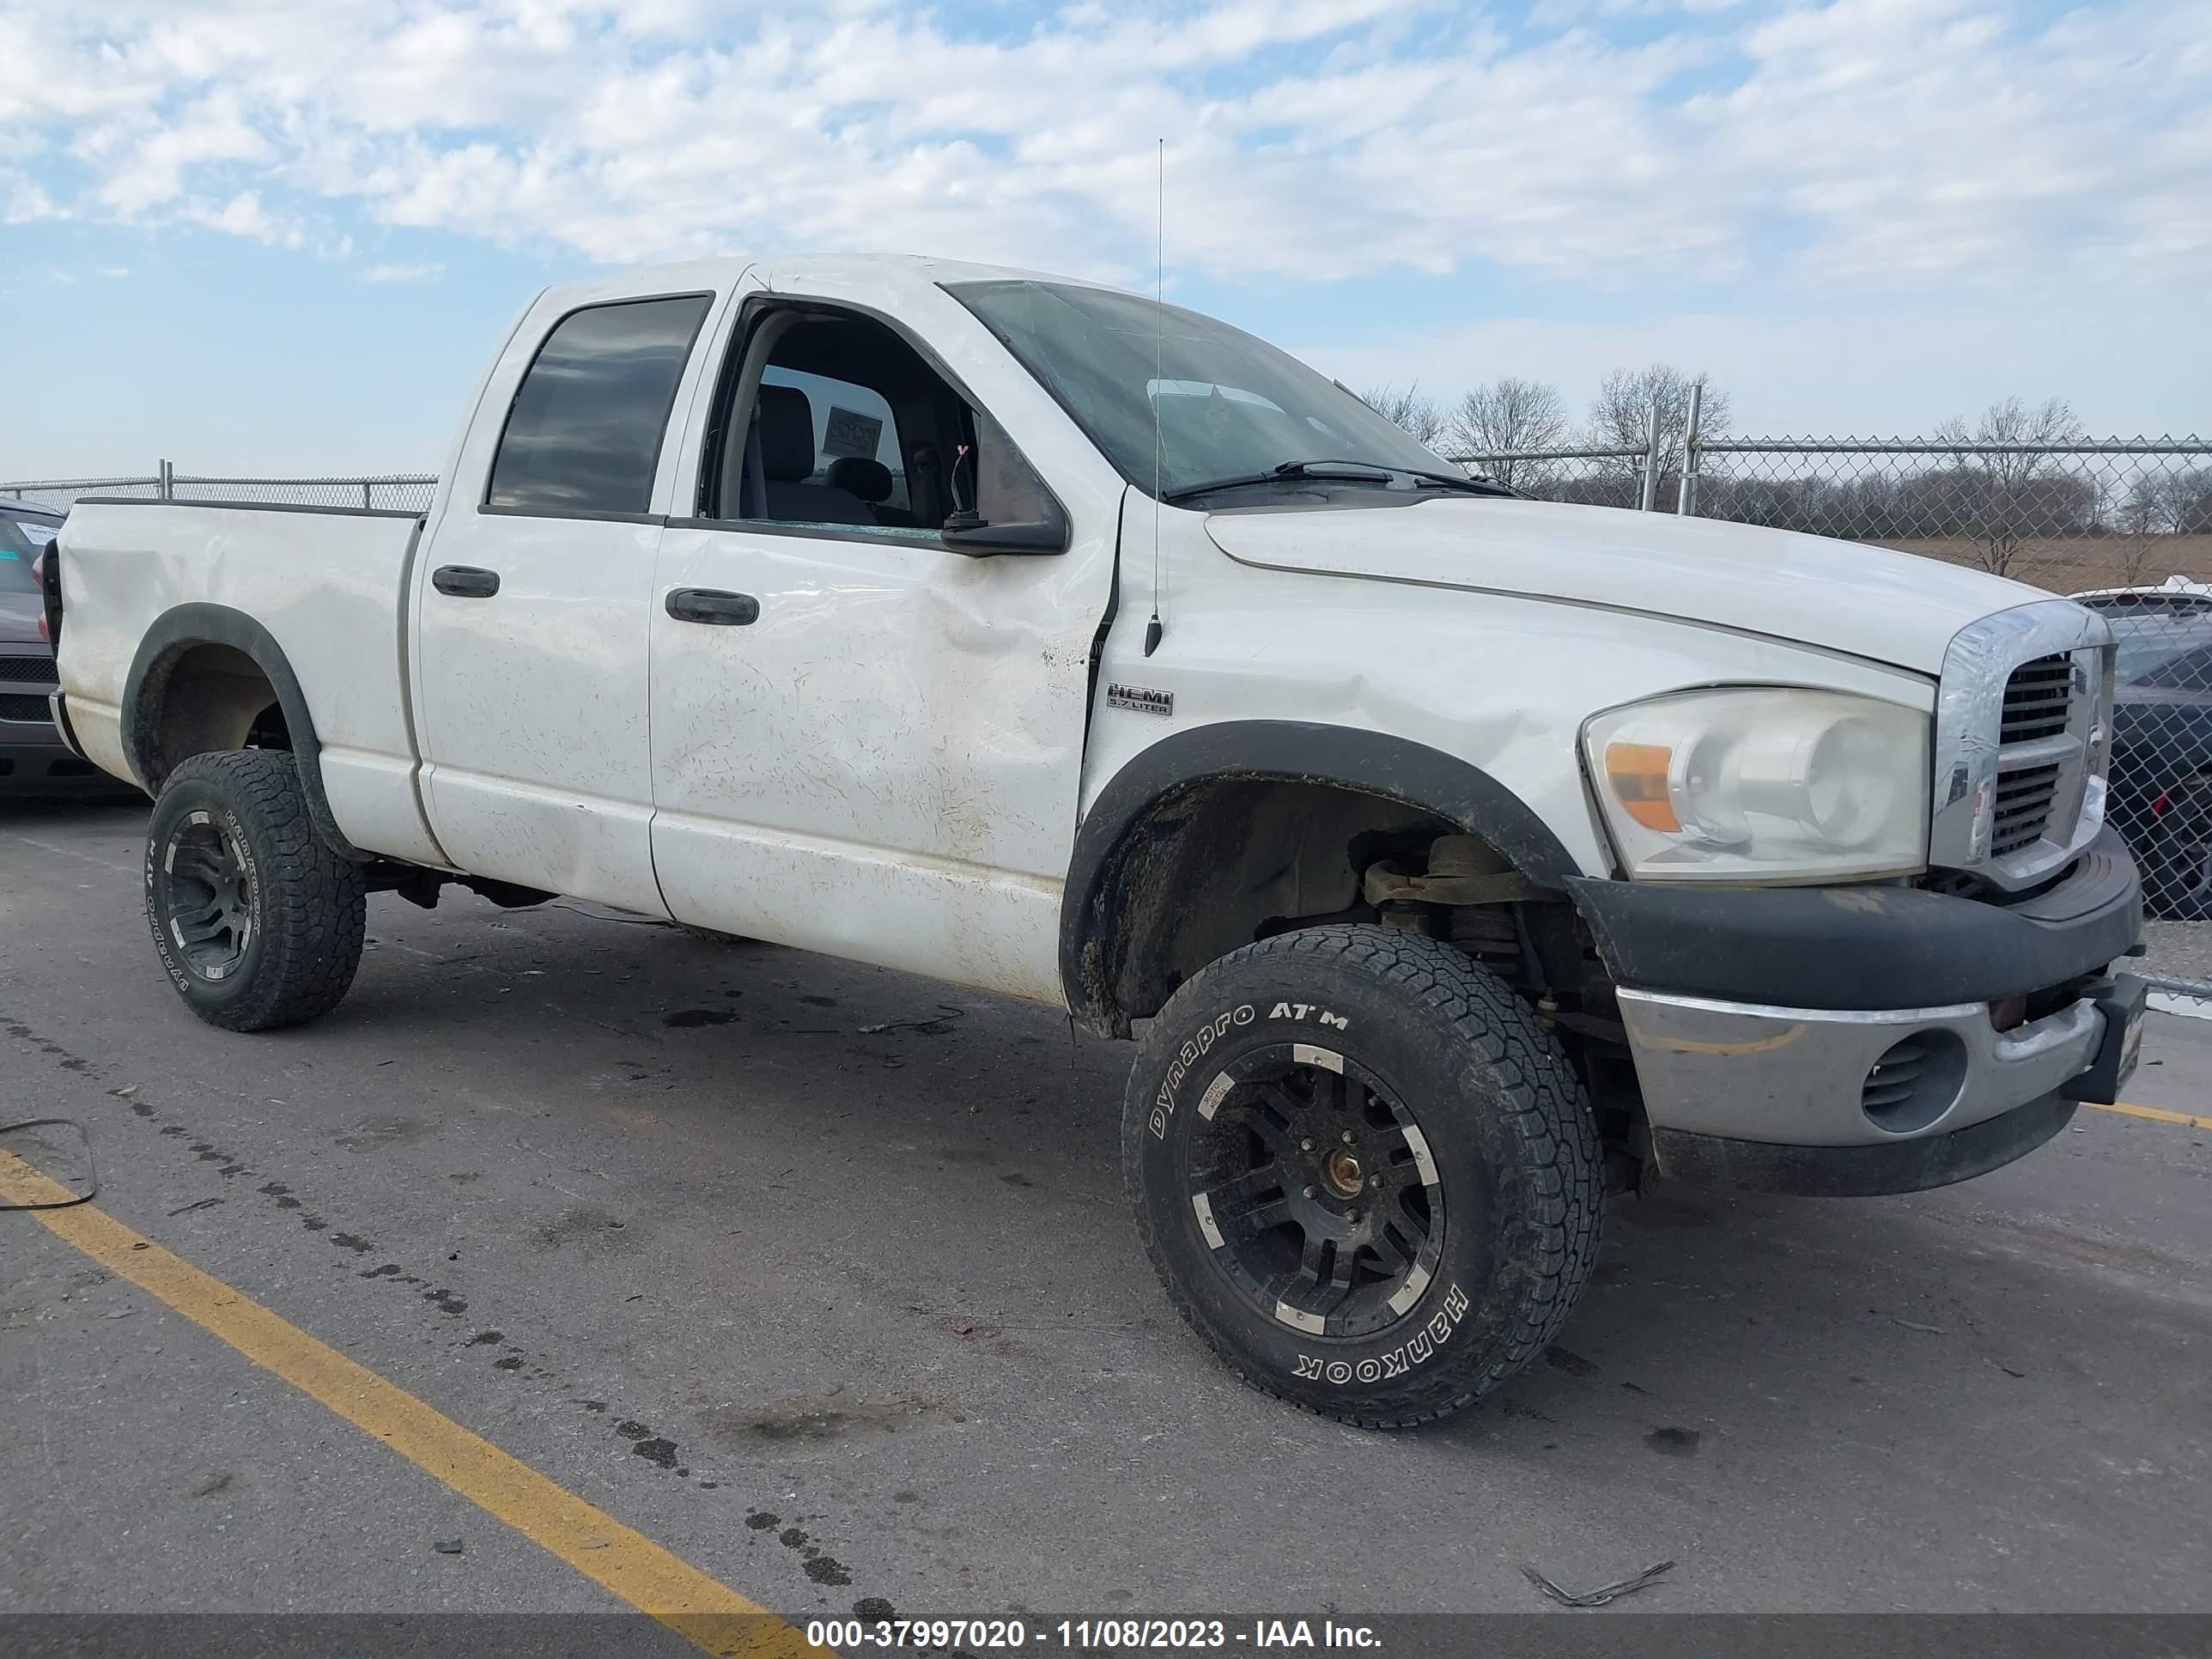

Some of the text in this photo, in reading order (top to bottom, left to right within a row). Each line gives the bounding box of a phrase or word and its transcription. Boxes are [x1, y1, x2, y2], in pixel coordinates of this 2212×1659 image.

[1108, 684, 1170, 704] HEMI
[1109, 698, 1168, 714] 5.7 LITER
[147, 896, 190, 992] Dynapro
[1149, 1005, 1255, 1140] Dynapro
[1204, 1082, 1219, 1105] MOTO
[1210, 1087, 1227, 1110] METAL
